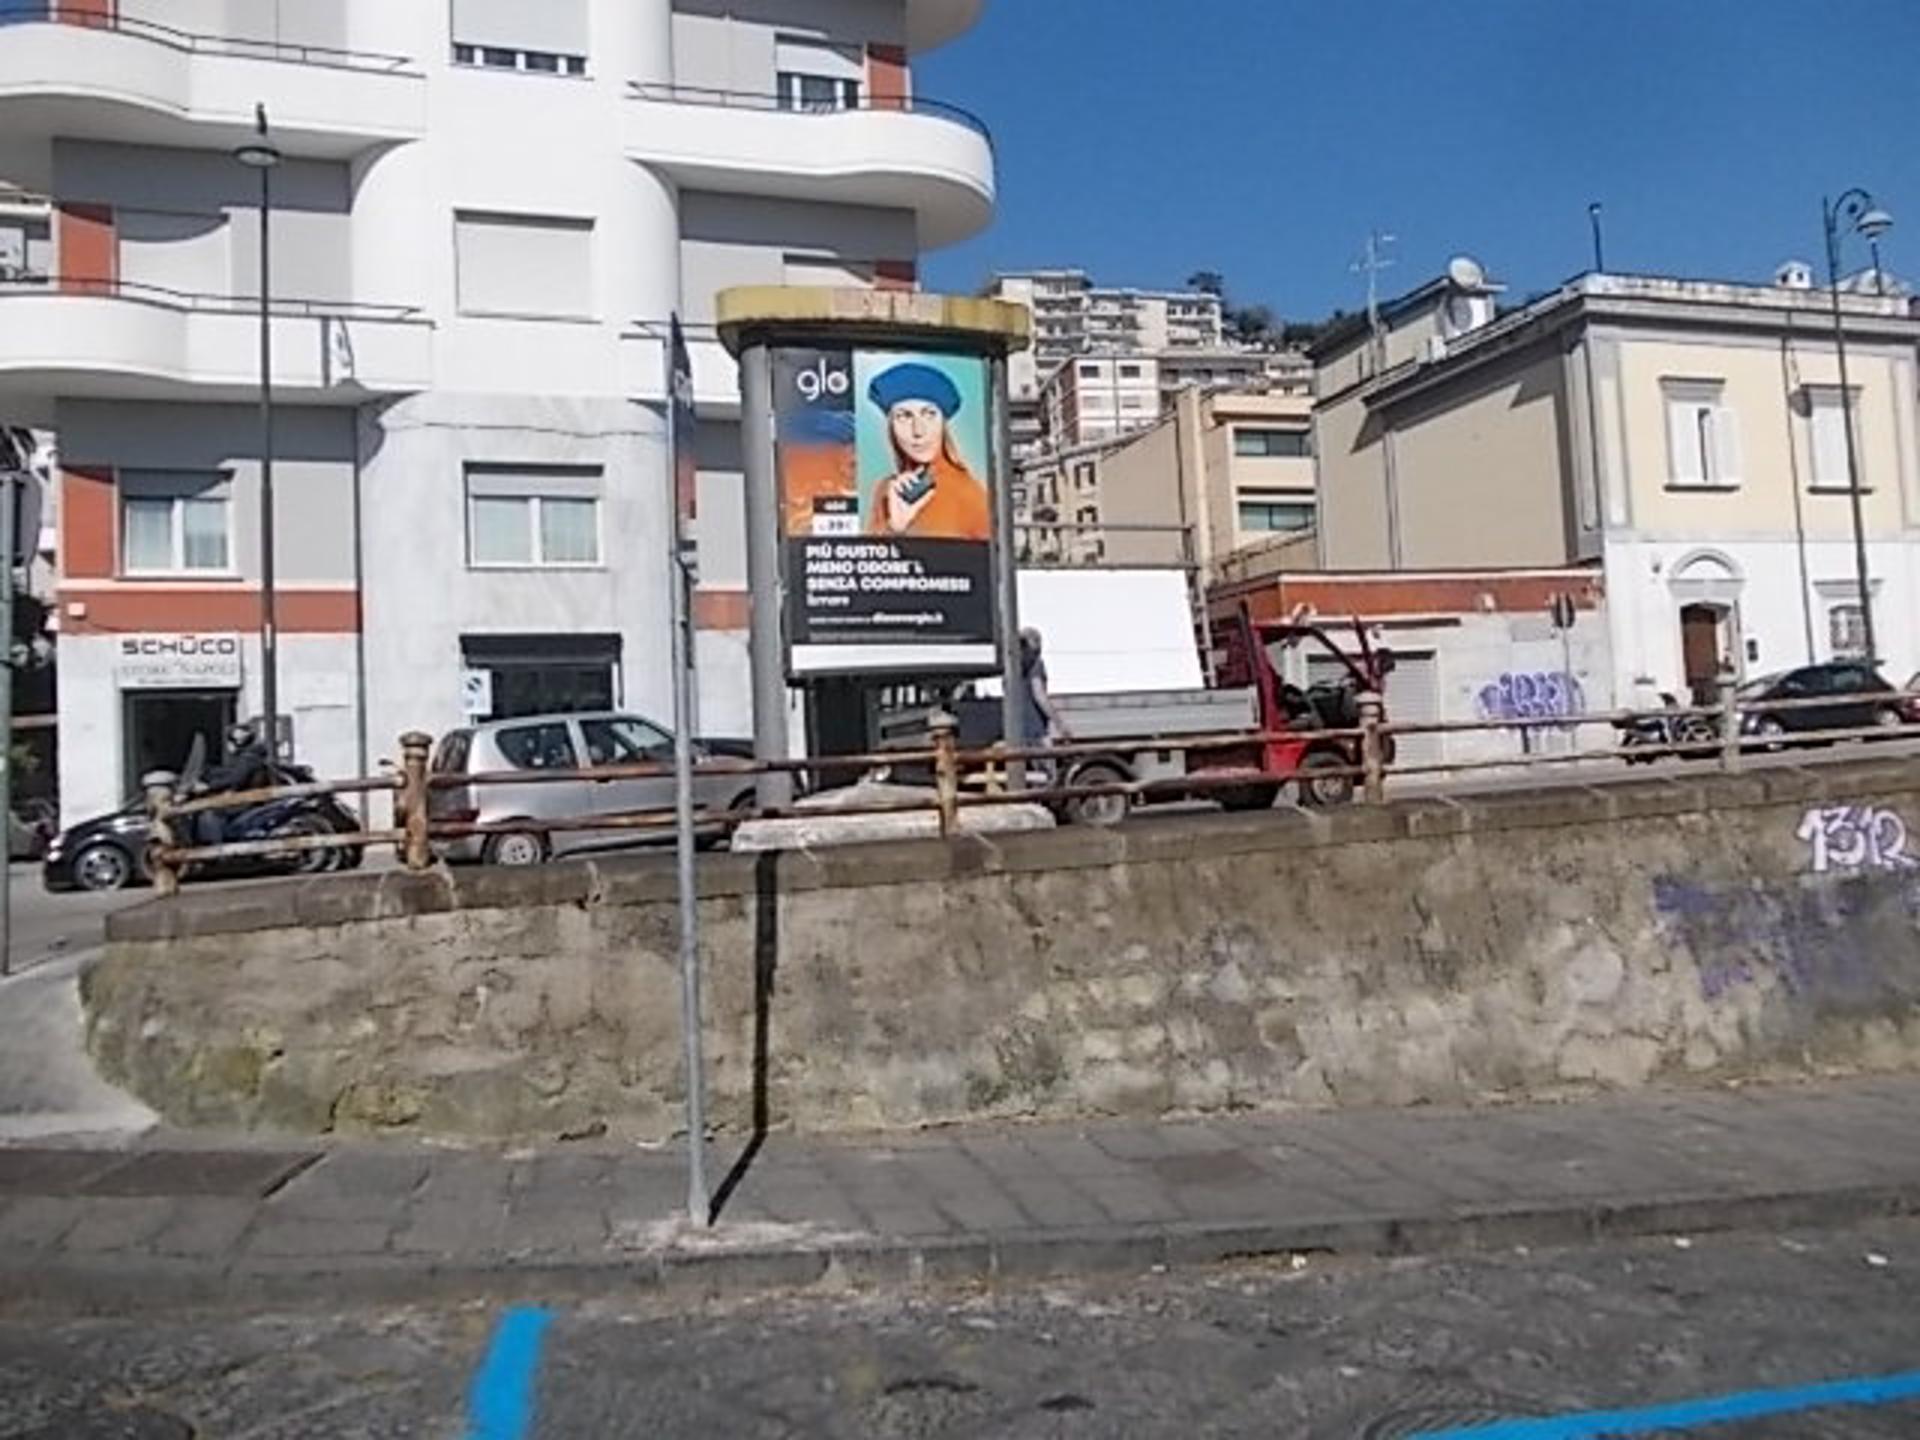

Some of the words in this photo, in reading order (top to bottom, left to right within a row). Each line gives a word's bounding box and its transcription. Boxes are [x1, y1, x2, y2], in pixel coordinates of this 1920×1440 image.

[797, 357, 849, 400] glo
[806, 560, 854, 574] MENO
[806, 577, 858, 591] SENZA
